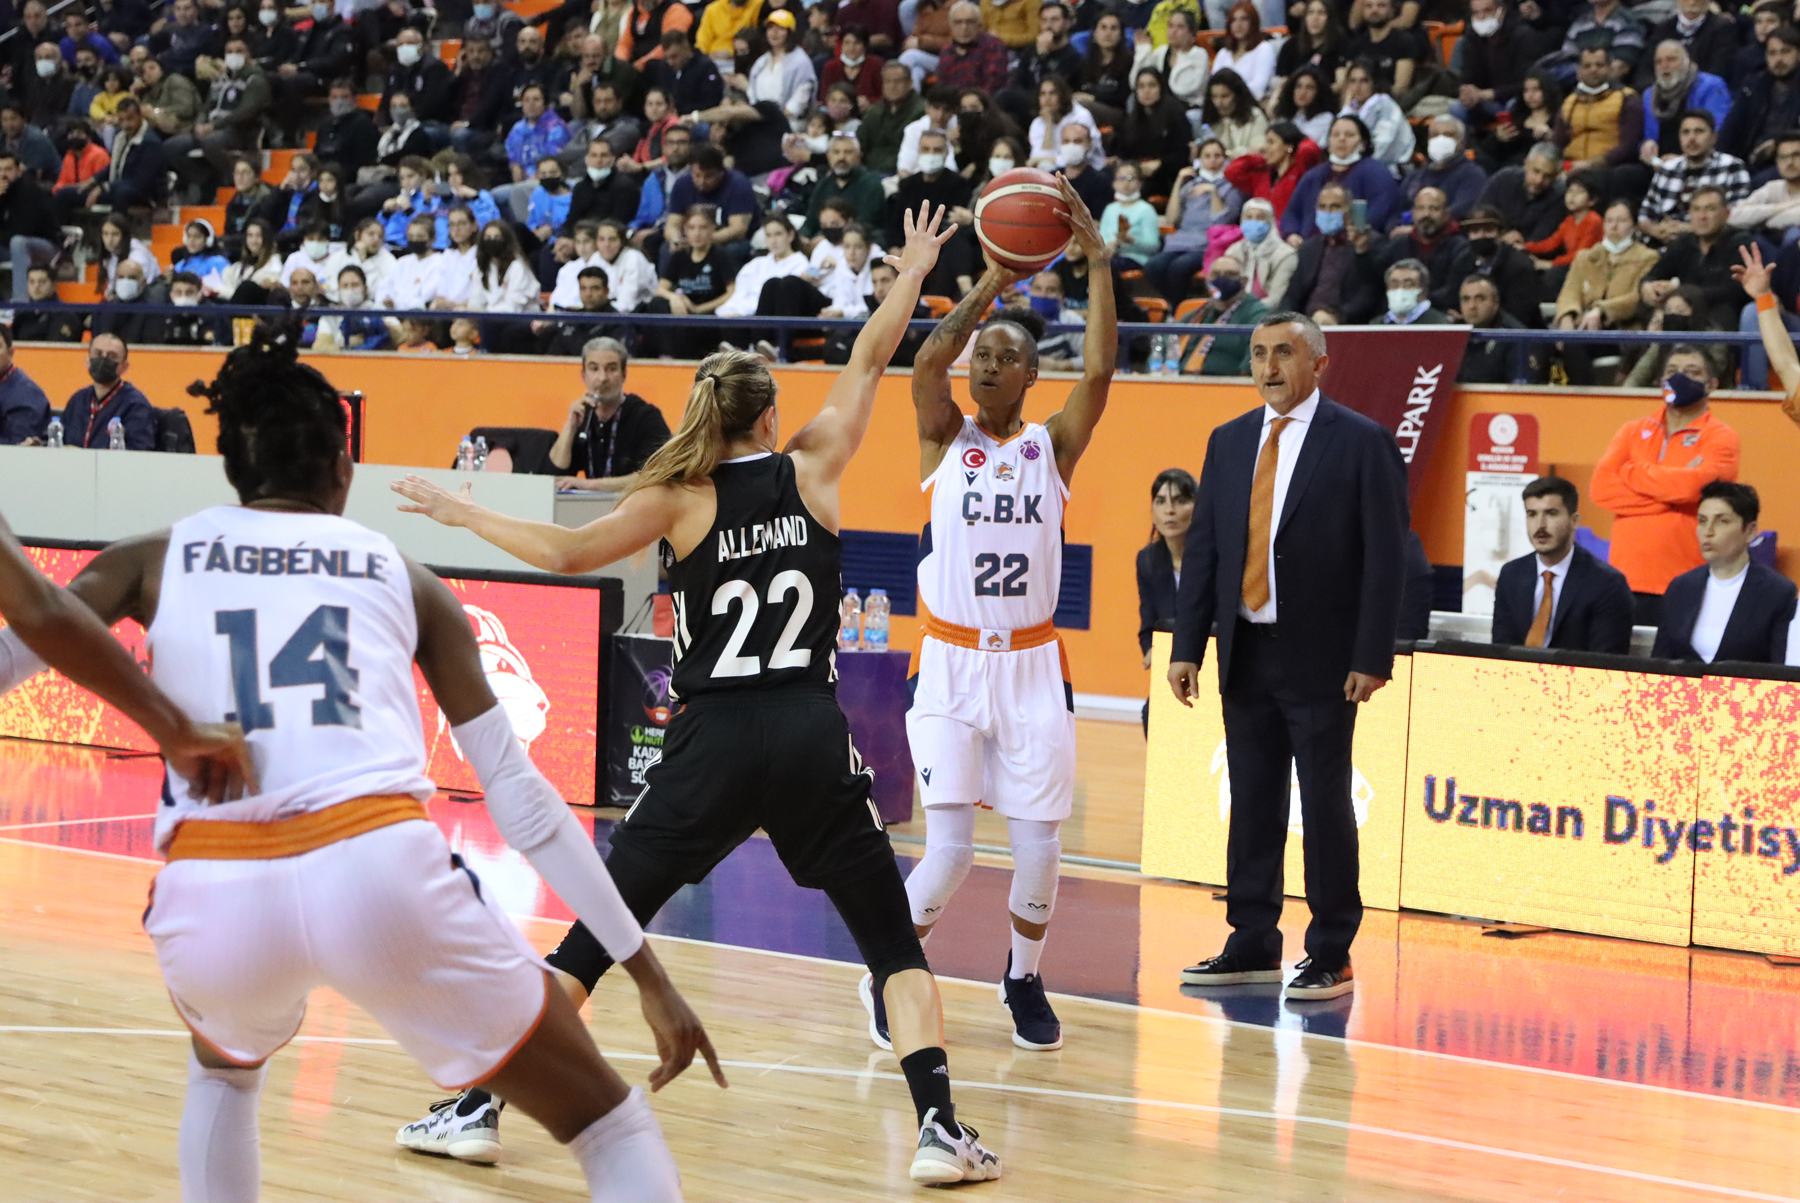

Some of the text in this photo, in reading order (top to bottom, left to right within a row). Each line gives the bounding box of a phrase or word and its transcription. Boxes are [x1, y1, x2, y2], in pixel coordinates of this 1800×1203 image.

[1396, 363, 1443, 463] LPARK
[962, 491, 1043, 526] Ç.B.K
[183, 535, 389, 584] FÁGBÉNLE
[718, 515, 808, 562] ALLEMAND
[975, 553, 1029, 597] 22
[710, 570, 814, 678] 22
[215, 604, 362, 734] 14
[1424, 774, 1584, 840] Uzman
